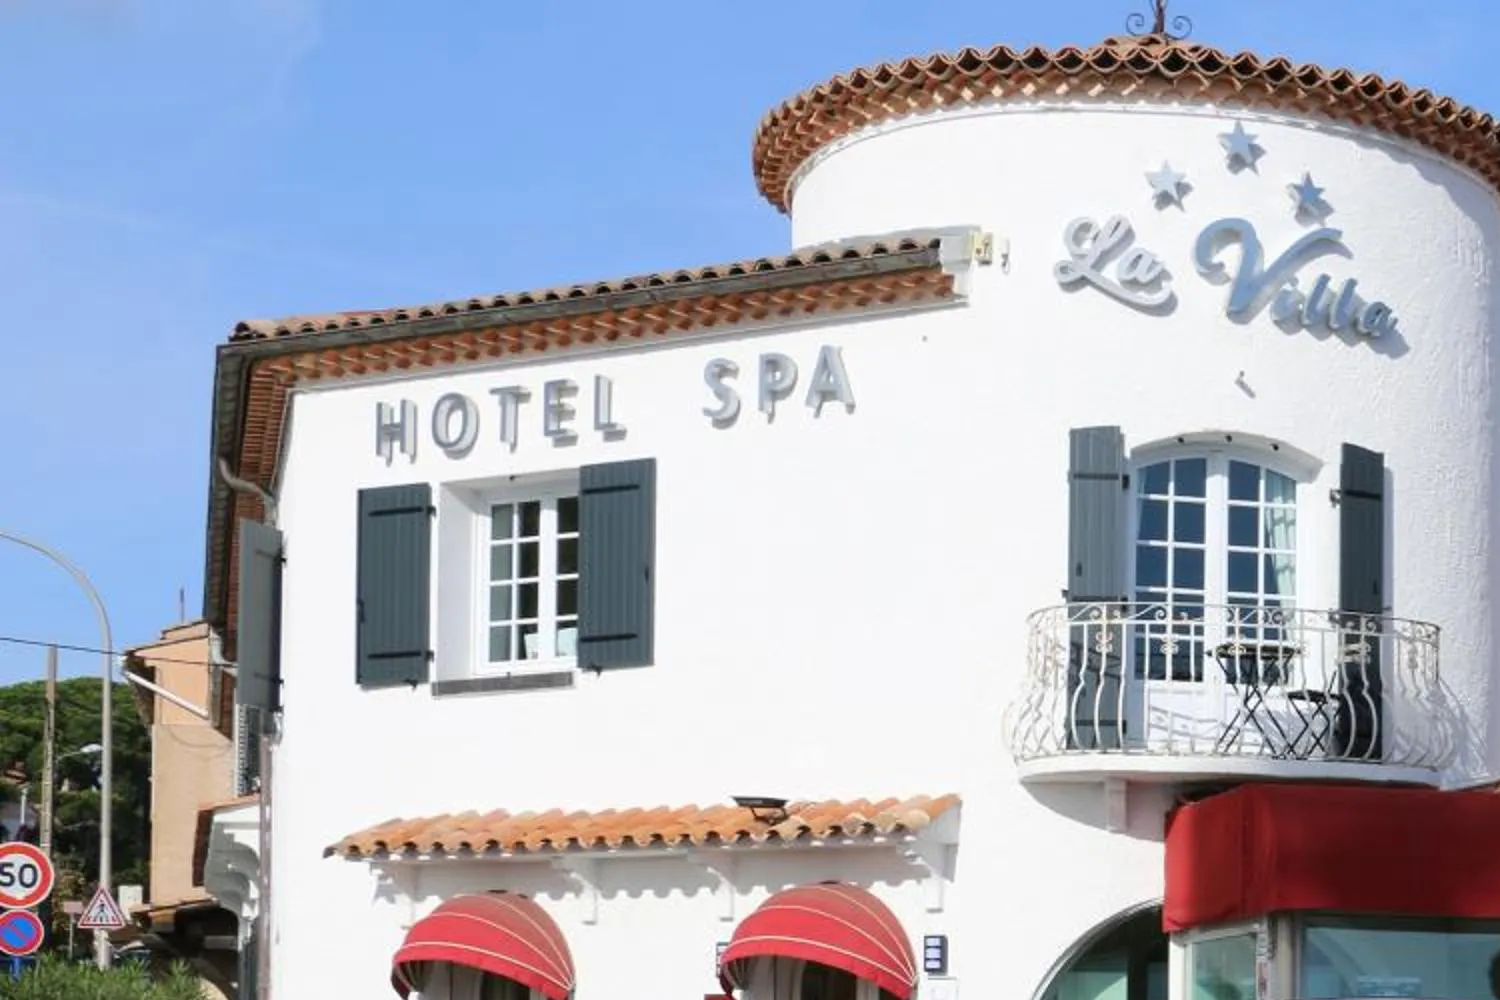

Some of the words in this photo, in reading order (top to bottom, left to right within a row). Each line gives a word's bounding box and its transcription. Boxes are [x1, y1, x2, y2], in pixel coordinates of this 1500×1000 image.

[1053, 214, 1176, 310] La
[1194, 216, 1404, 345] Villa
[376, 374, 626, 465] HOTEL
[702, 345, 856, 428] SPA
[0, 862, 38, 888] 50
